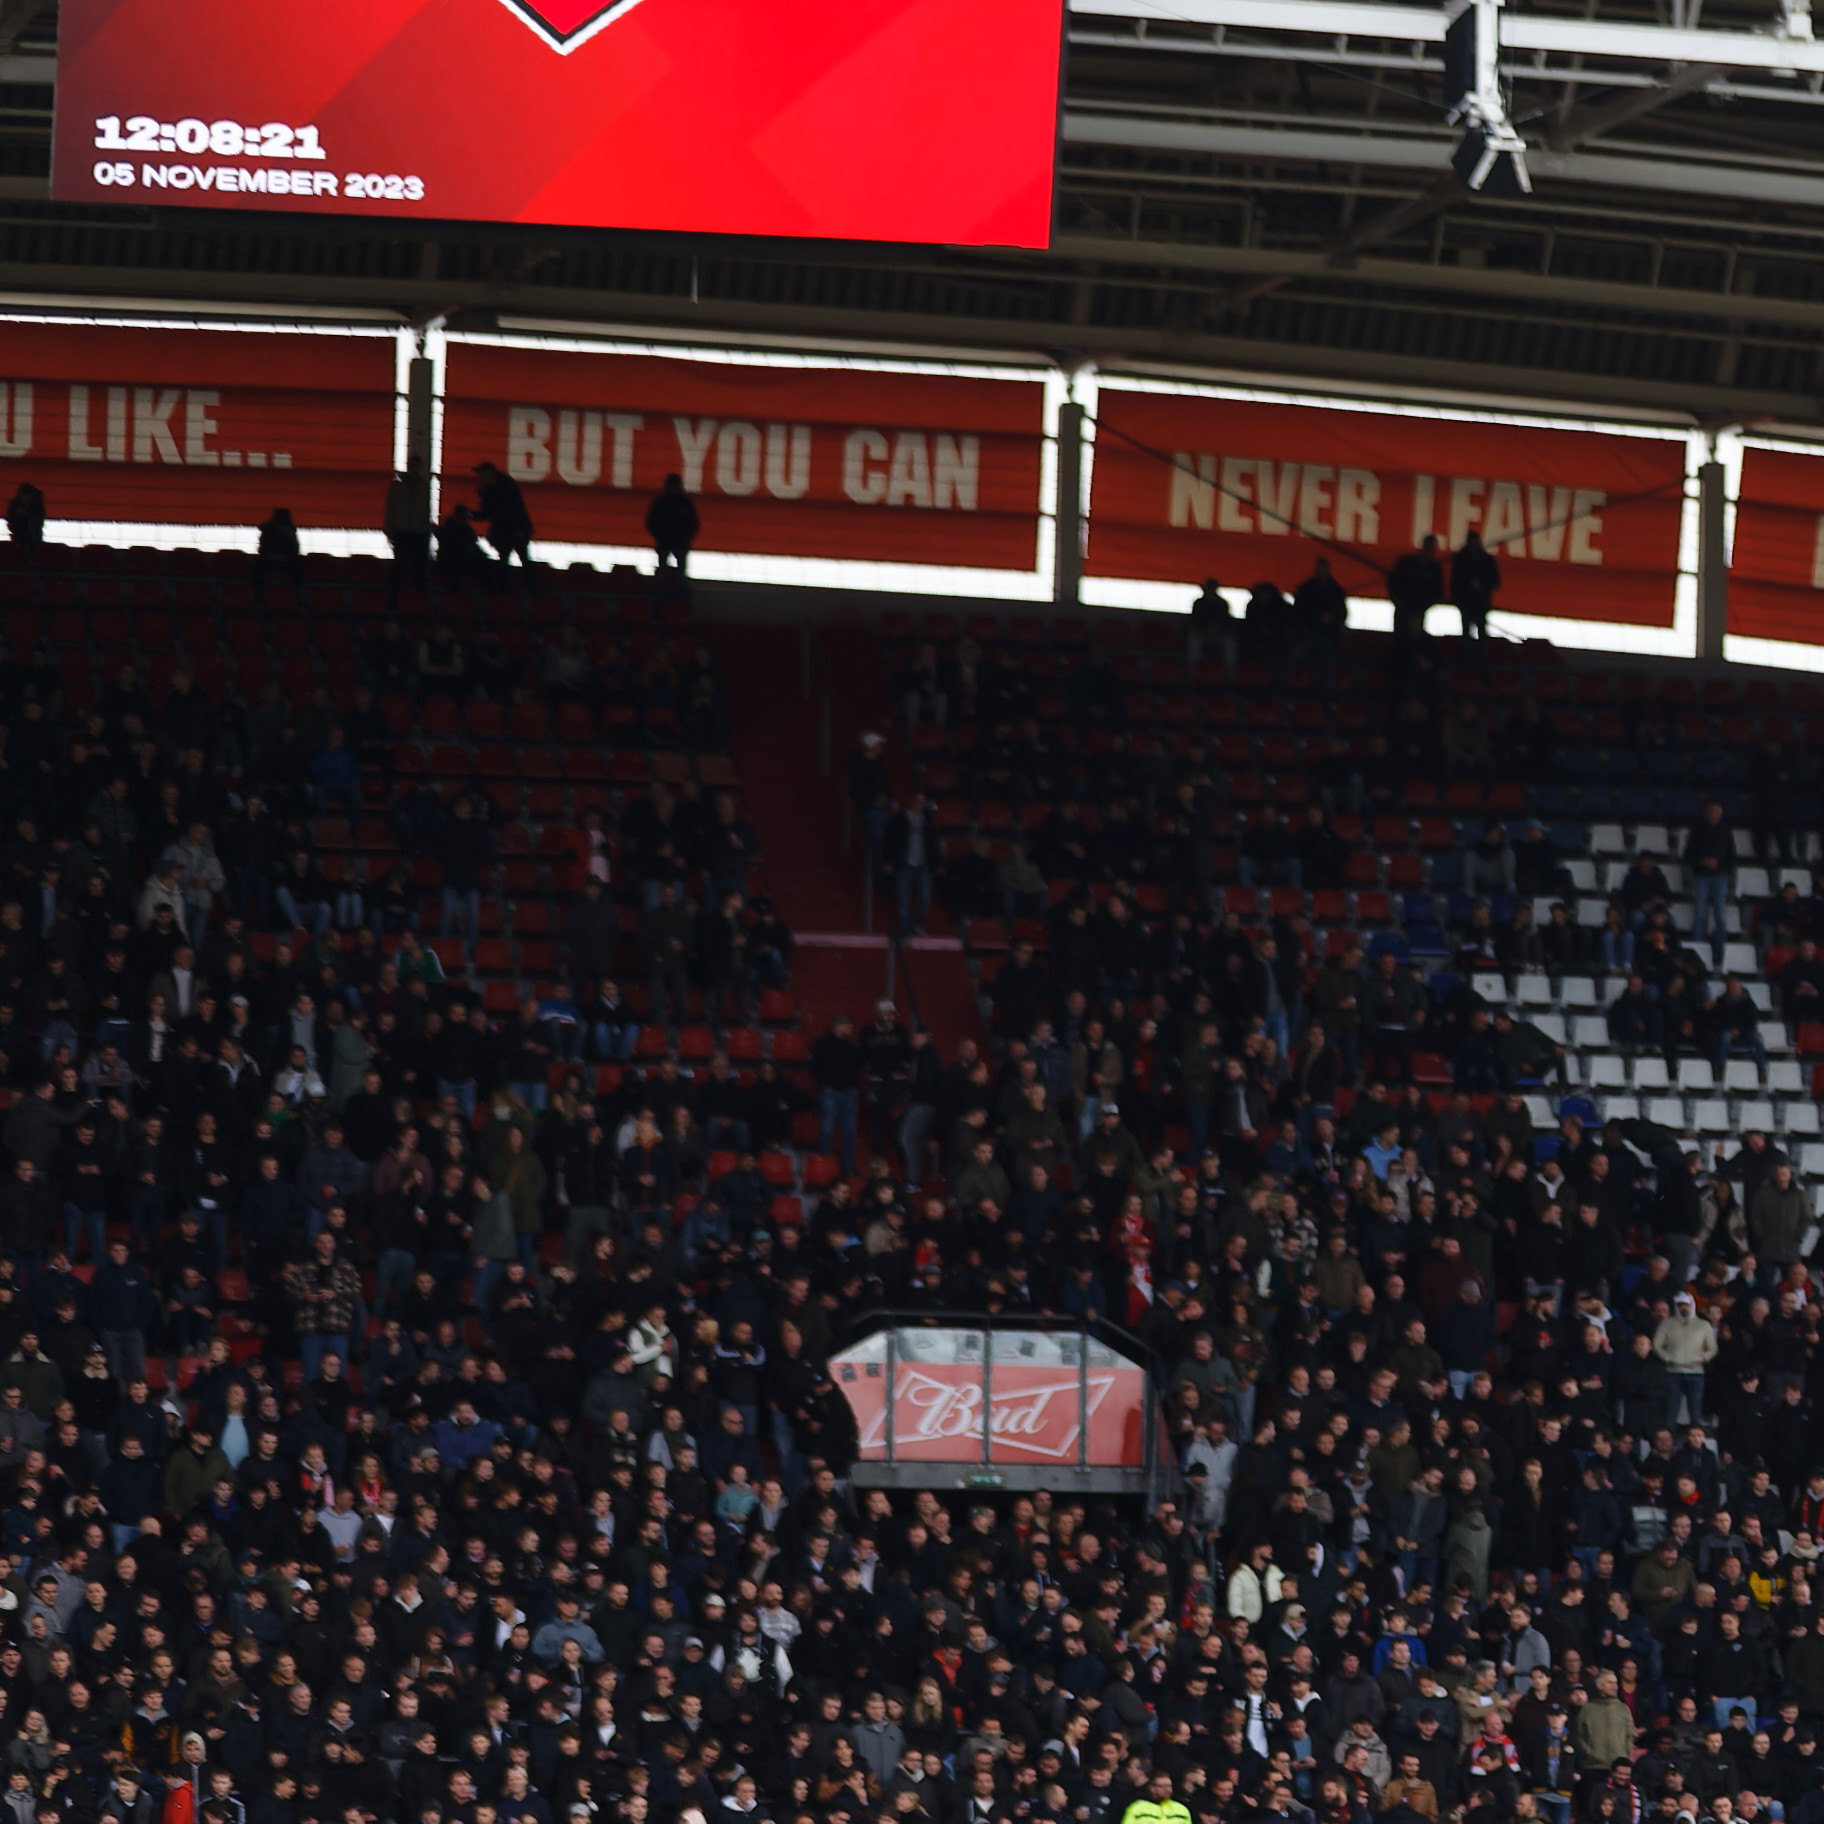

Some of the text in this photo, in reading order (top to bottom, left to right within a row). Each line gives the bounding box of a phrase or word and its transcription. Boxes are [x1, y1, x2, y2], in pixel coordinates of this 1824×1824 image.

[95, 116, 326, 160] 12:08:21
[93, 161, 425, 201] 05 NOVEMBER 2023
[67, 386, 293, 470] LIKE...
[507, 406, 981, 510] BUT YOU CAN
[1169, 452, 1607, 565] NEVER LEAVE
[909, 1383, 1053, 1437] Bud
